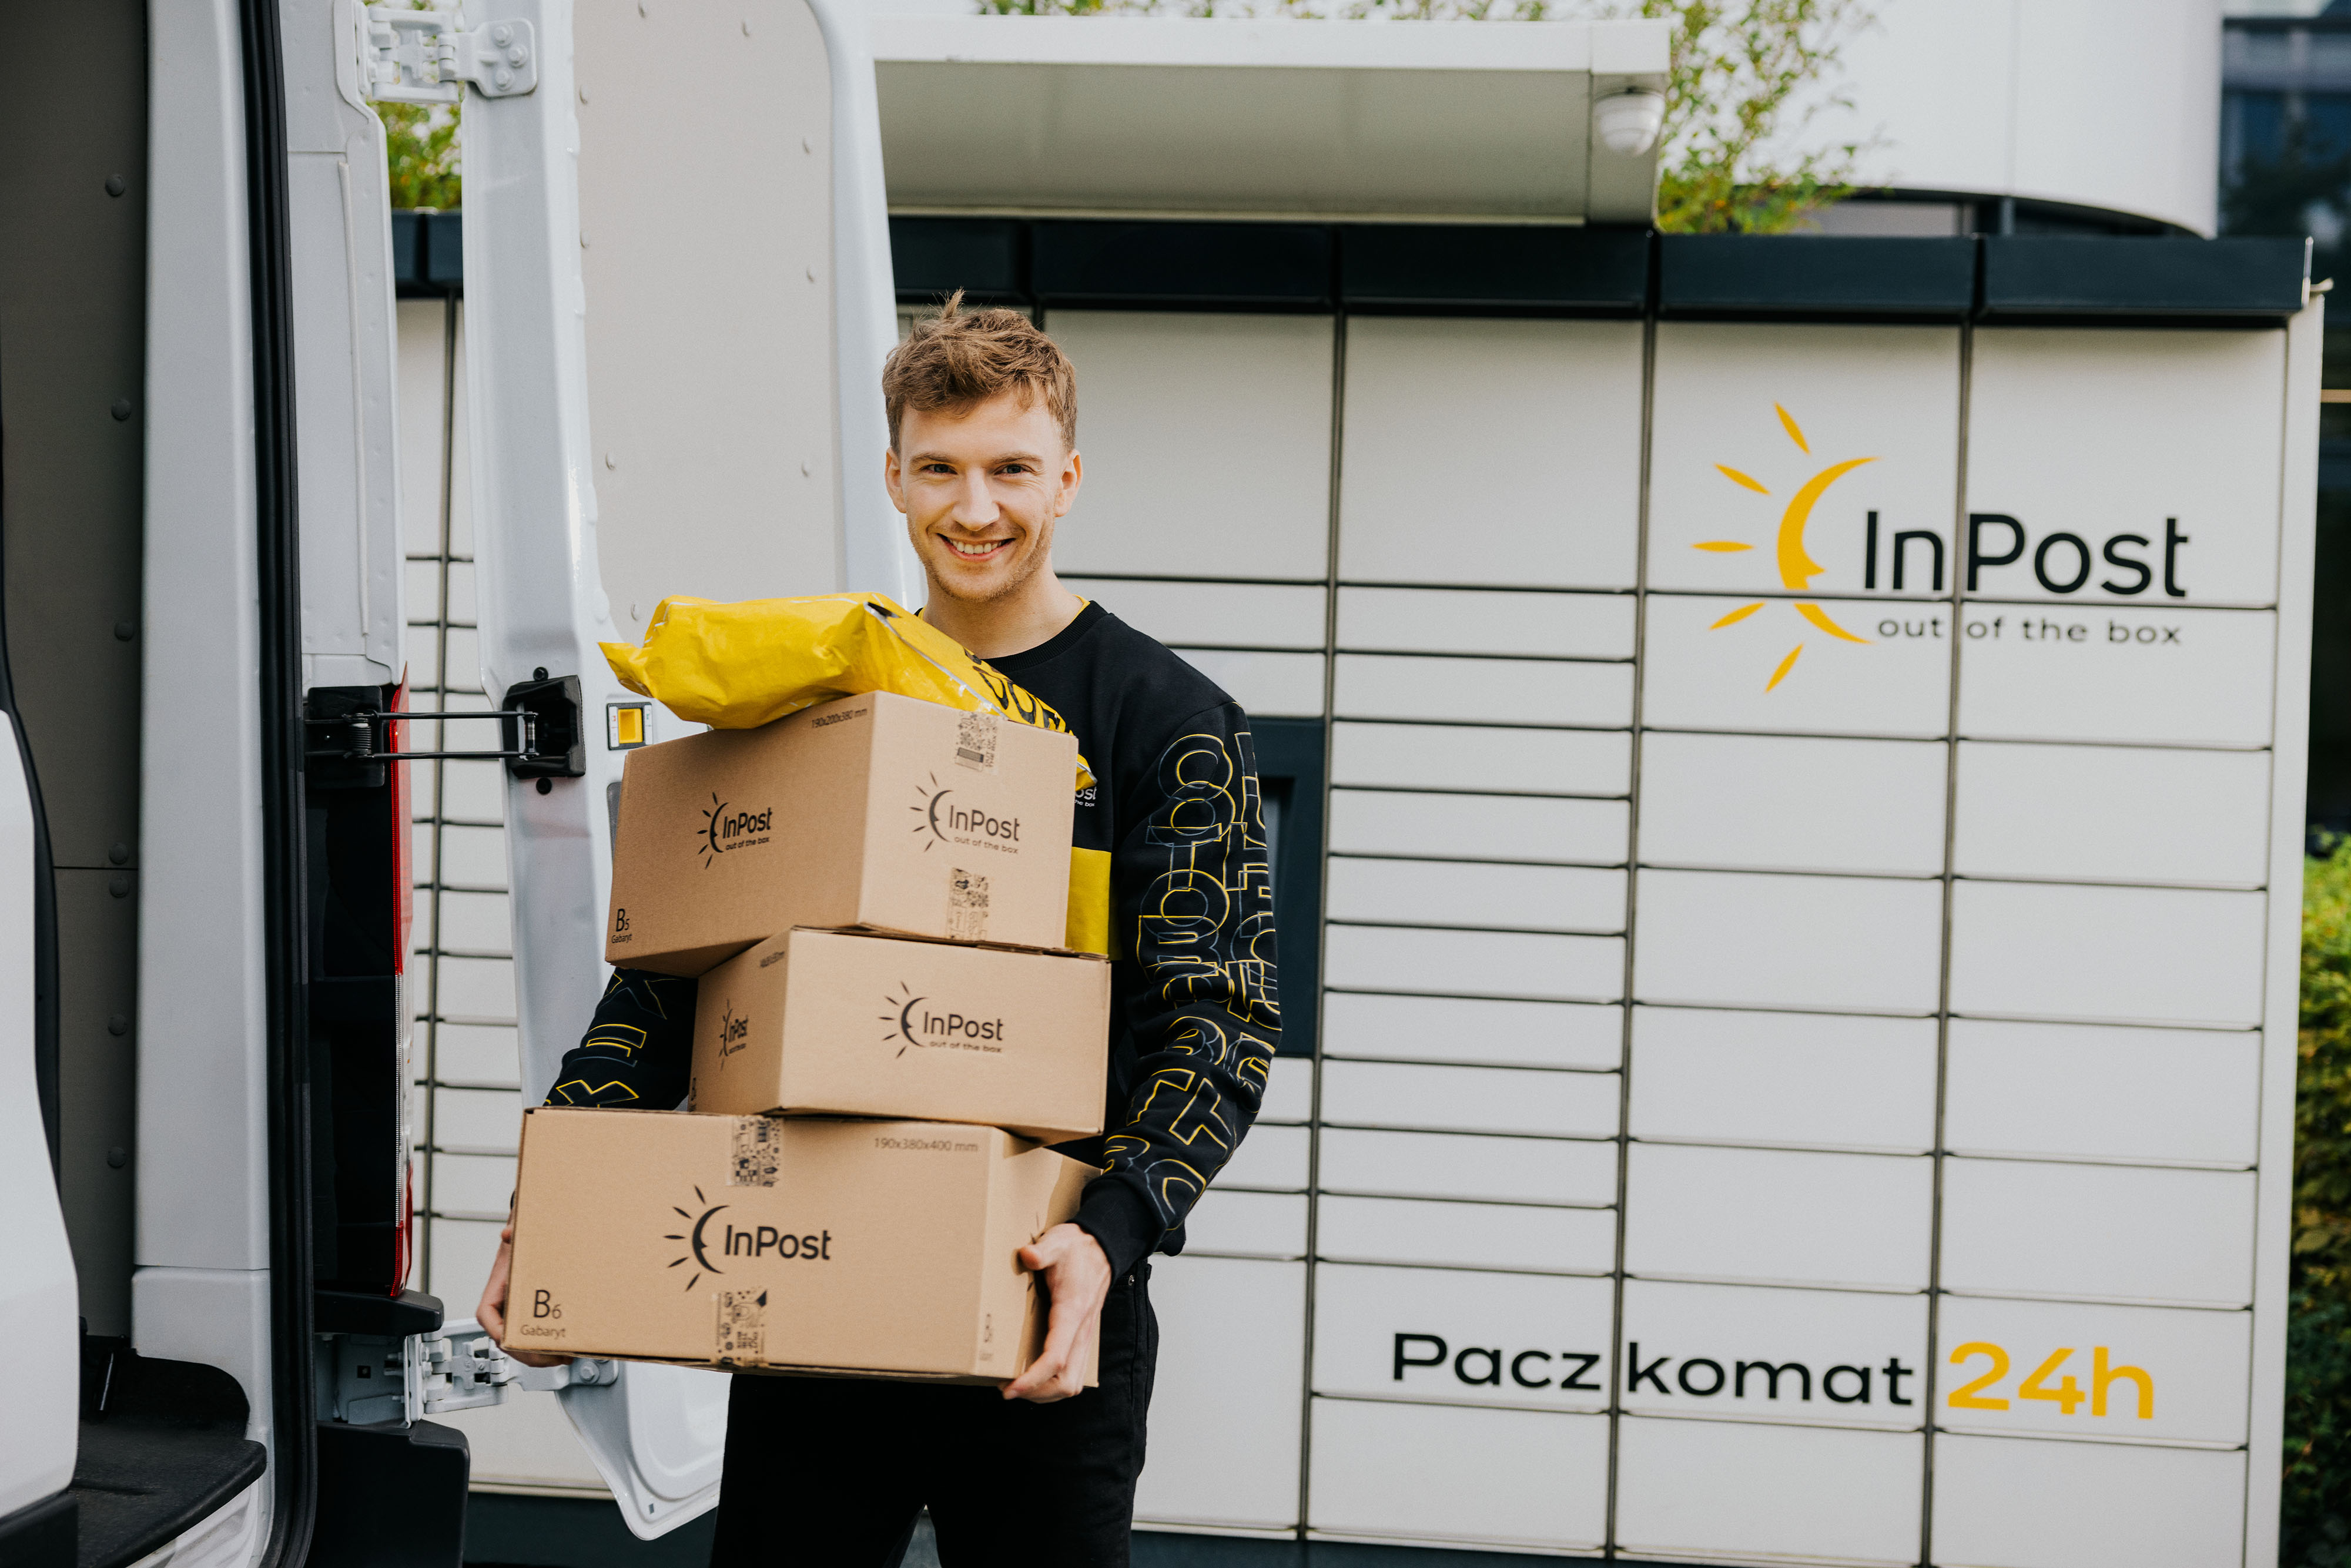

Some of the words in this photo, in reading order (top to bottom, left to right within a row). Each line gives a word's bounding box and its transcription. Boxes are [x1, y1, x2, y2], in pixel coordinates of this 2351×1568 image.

[1864, 510, 2190, 598] InPost
[1878, 618, 1944, 638] out
[1965, 617, 2004, 640] of
[2022, 619, 2088, 644] the
[2107, 620, 2181, 645] box
[1076, 786, 1097, 800] ost
[722, 807, 773, 839] InPost
[949, 805, 1020, 842] InPost
[955, 836, 970, 845] out
[984, 842, 999, 851] the
[1002, 844, 1019, 855] box
[616, 908, 631, 932] B5
[611, 933, 633, 944] Gabaryt
[924, 1011, 1003, 1041] InPost
[982, 1045, 1002, 1053] box
[875, 1138, 952, 1152] 190x380x400
[955, 1143, 979, 1152] mm
[725, 1224, 832, 1261] InPost
[534, 1289, 562, 1319] B6
[520, 1324, 565, 1340] Gabaryt
[1948, 1341, 2154, 1420] 24h
